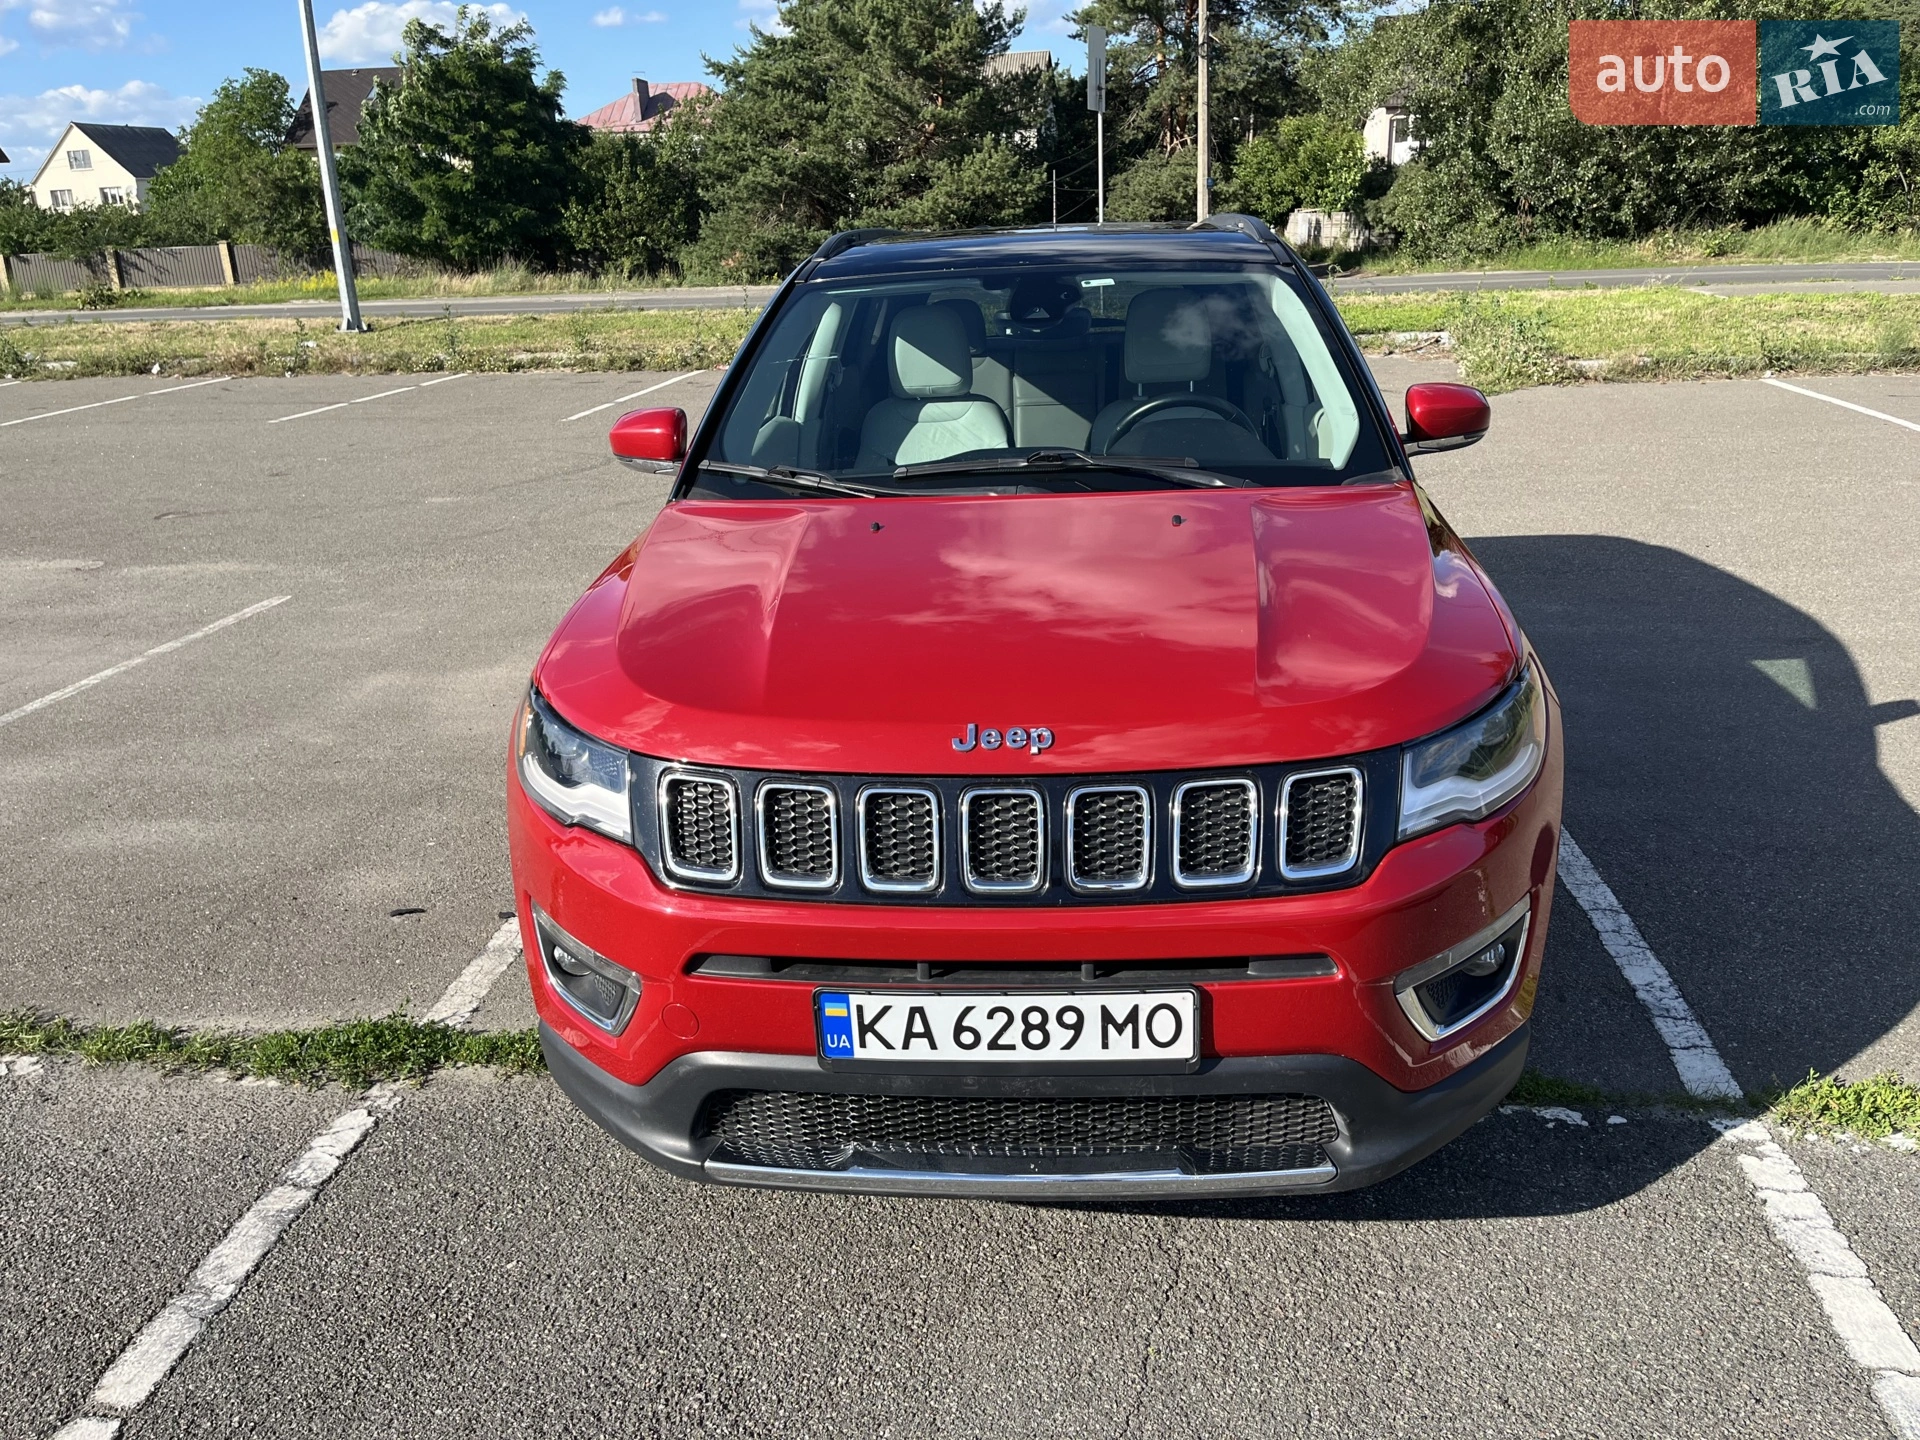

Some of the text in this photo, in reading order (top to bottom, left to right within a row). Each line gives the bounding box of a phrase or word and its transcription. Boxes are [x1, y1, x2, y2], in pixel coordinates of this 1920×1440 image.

[951, 723, 1055, 755] Jeep
[826, 1033, 851, 1049] UA
[856, 1002, 1183, 1051] KA 6289 MO
